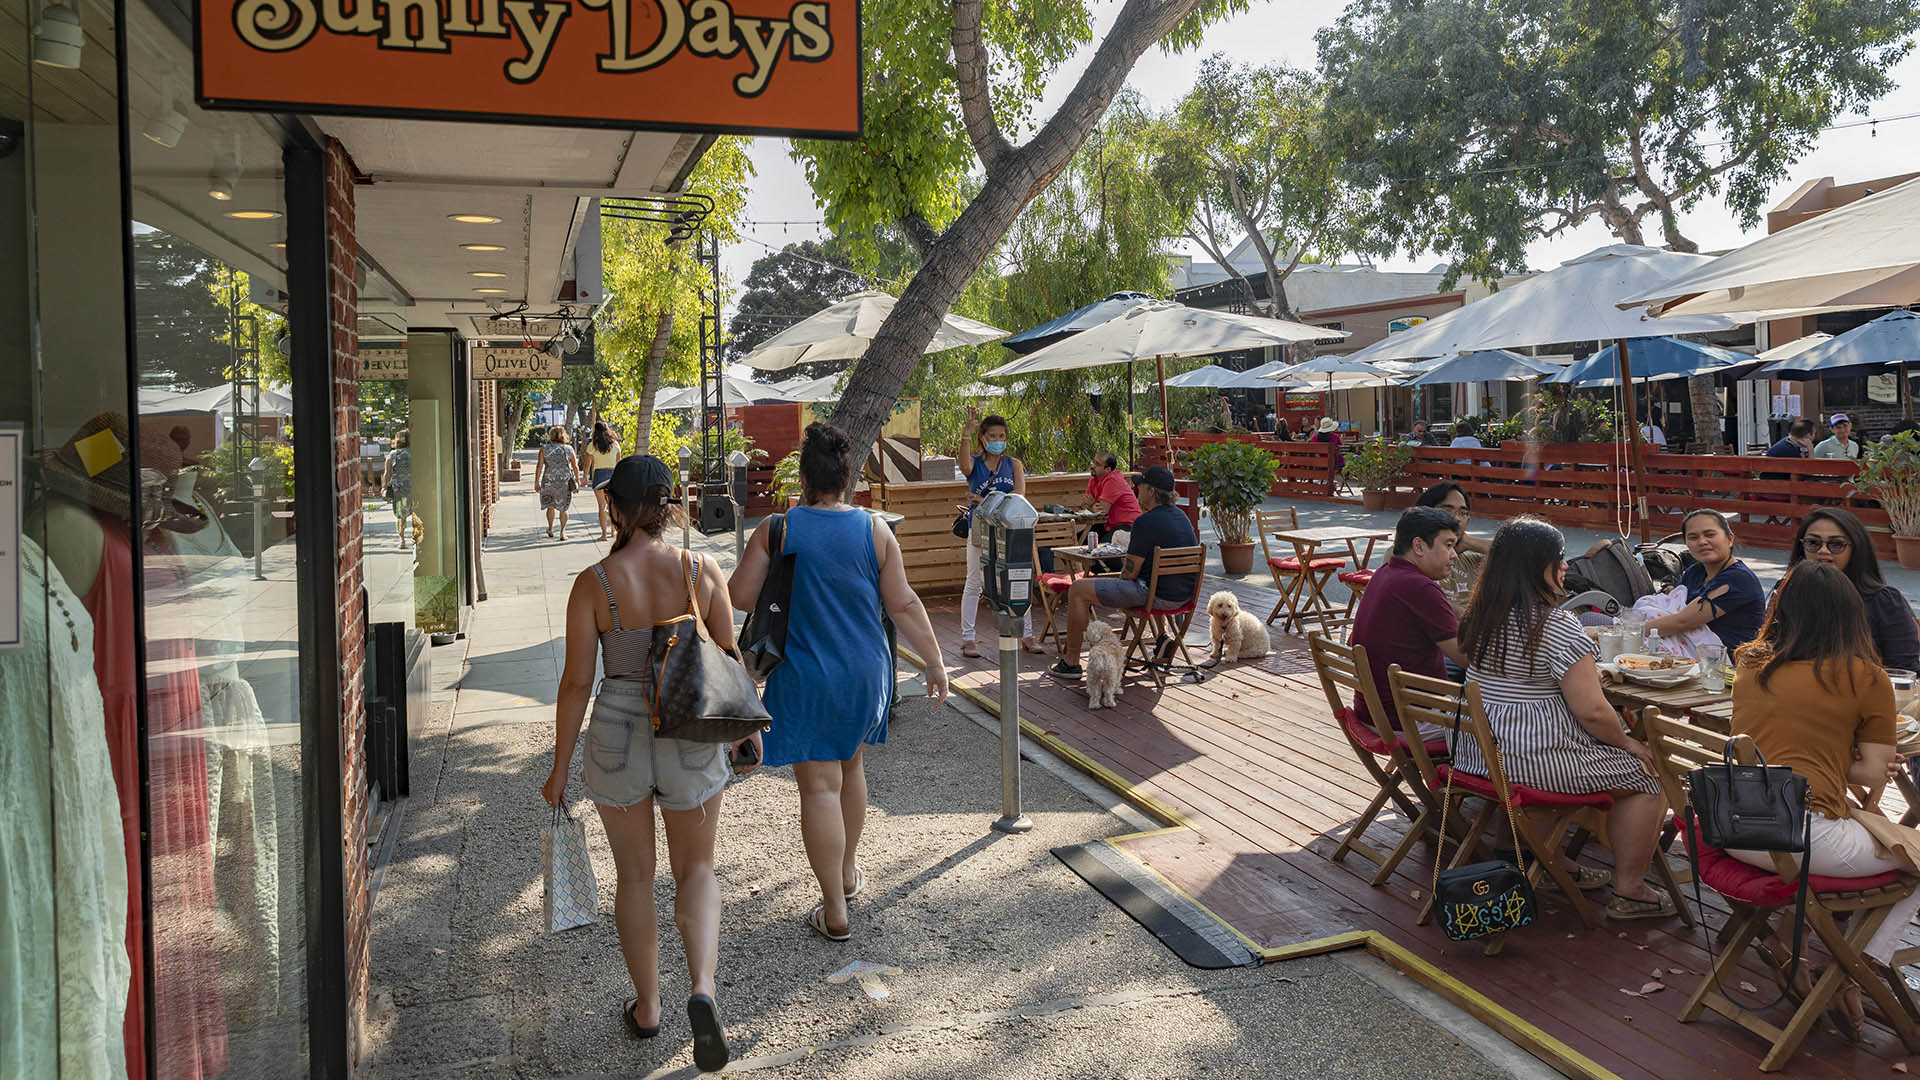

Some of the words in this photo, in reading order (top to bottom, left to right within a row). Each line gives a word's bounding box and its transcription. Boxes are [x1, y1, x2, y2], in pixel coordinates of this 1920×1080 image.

[233, 0, 569, 84] Sunny
[577, 0, 834, 98] Days
[485, 354, 527, 372] OLIVE
[529, 354, 550, 372] OIL
